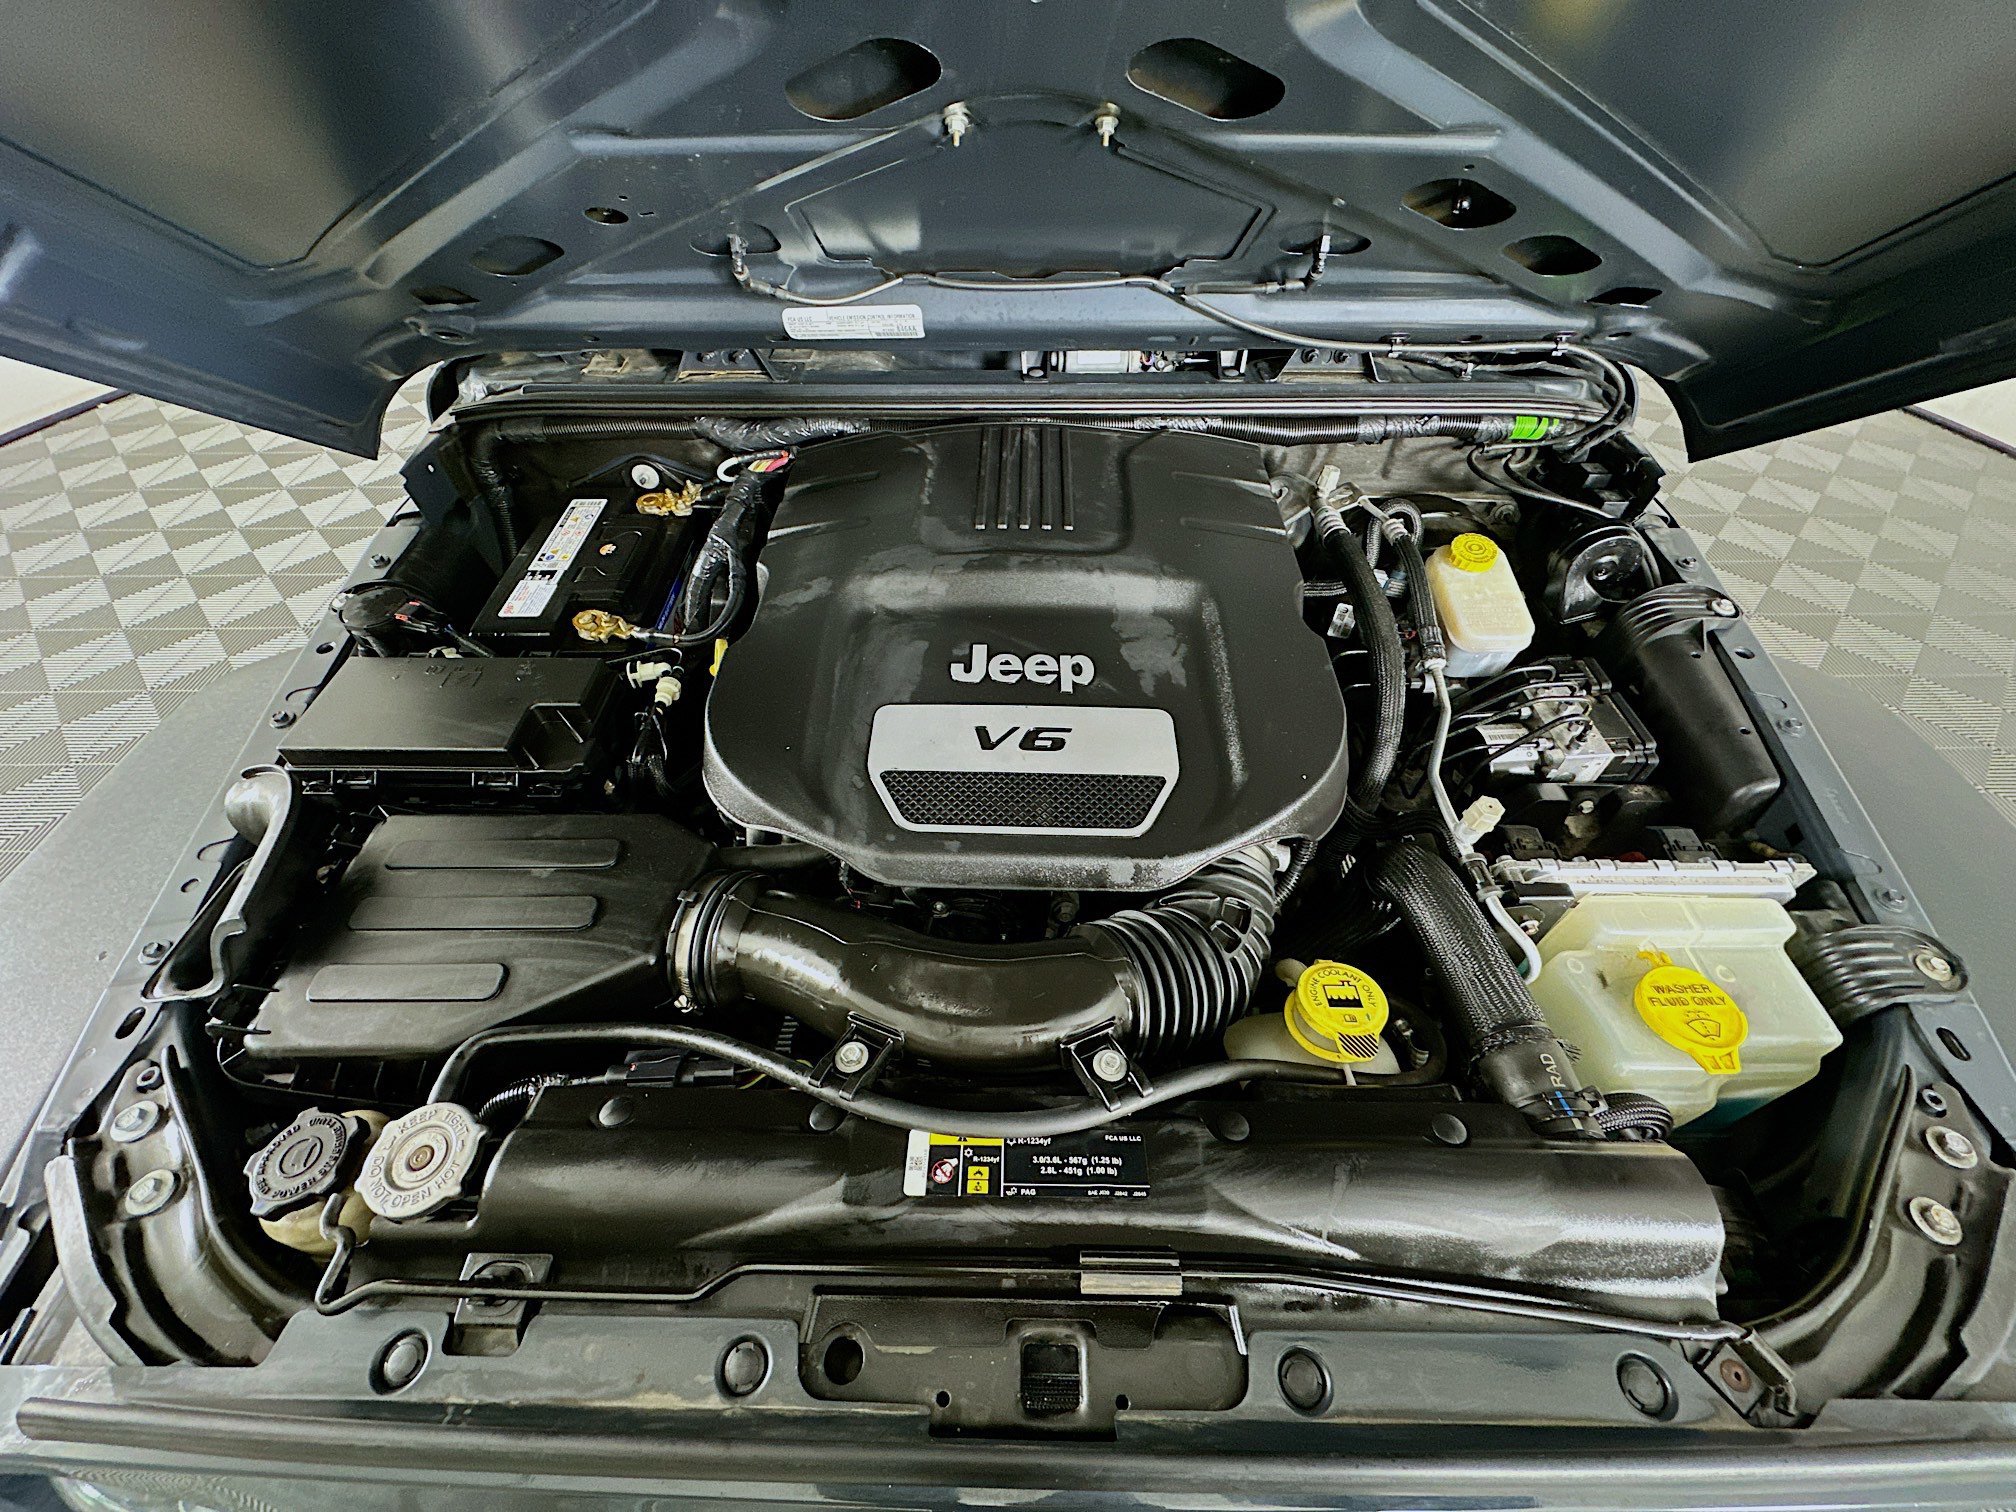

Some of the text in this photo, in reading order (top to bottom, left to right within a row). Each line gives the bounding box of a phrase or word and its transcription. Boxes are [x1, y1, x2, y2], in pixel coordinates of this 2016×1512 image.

[950, 643, 1095, 693] Jeep
[974, 725, 1073, 752] V6
[1309, 968, 1377, 1008] ENGINE COOLANT ONLY
[1651, 983, 1713, 994] WASHER
[1647, 996, 1727, 1007] FLUID ONLY
[1539, 1053, 1567, 1088] RAD
[398, 1109, 470, 1136] KEEP TIGHT
[1018, 1137, 1052, 1146] R-1234yf
[369, 1156, 385, 1178] DO
[1040, 1167, 1057, 1175] 2.8L
[1063, 1167, 1083, 1176] 451g
[1086, 1167, 1106, 1176] (1.00
[1107, 1167, 1118, 1176] lb)
[1068, 1156, 1088, 1165] 567g
[1091, 1156, 1110, 1165] (1.25
[1111, 1156, 1122, 1166] lb)
[435, 1160, 461, 1190] HOT
[370, 1177, 392, 1203] NOT
[391, 1186, 431, 1209] OPEN
[1020, 1188, 1037, 1196] PAG
